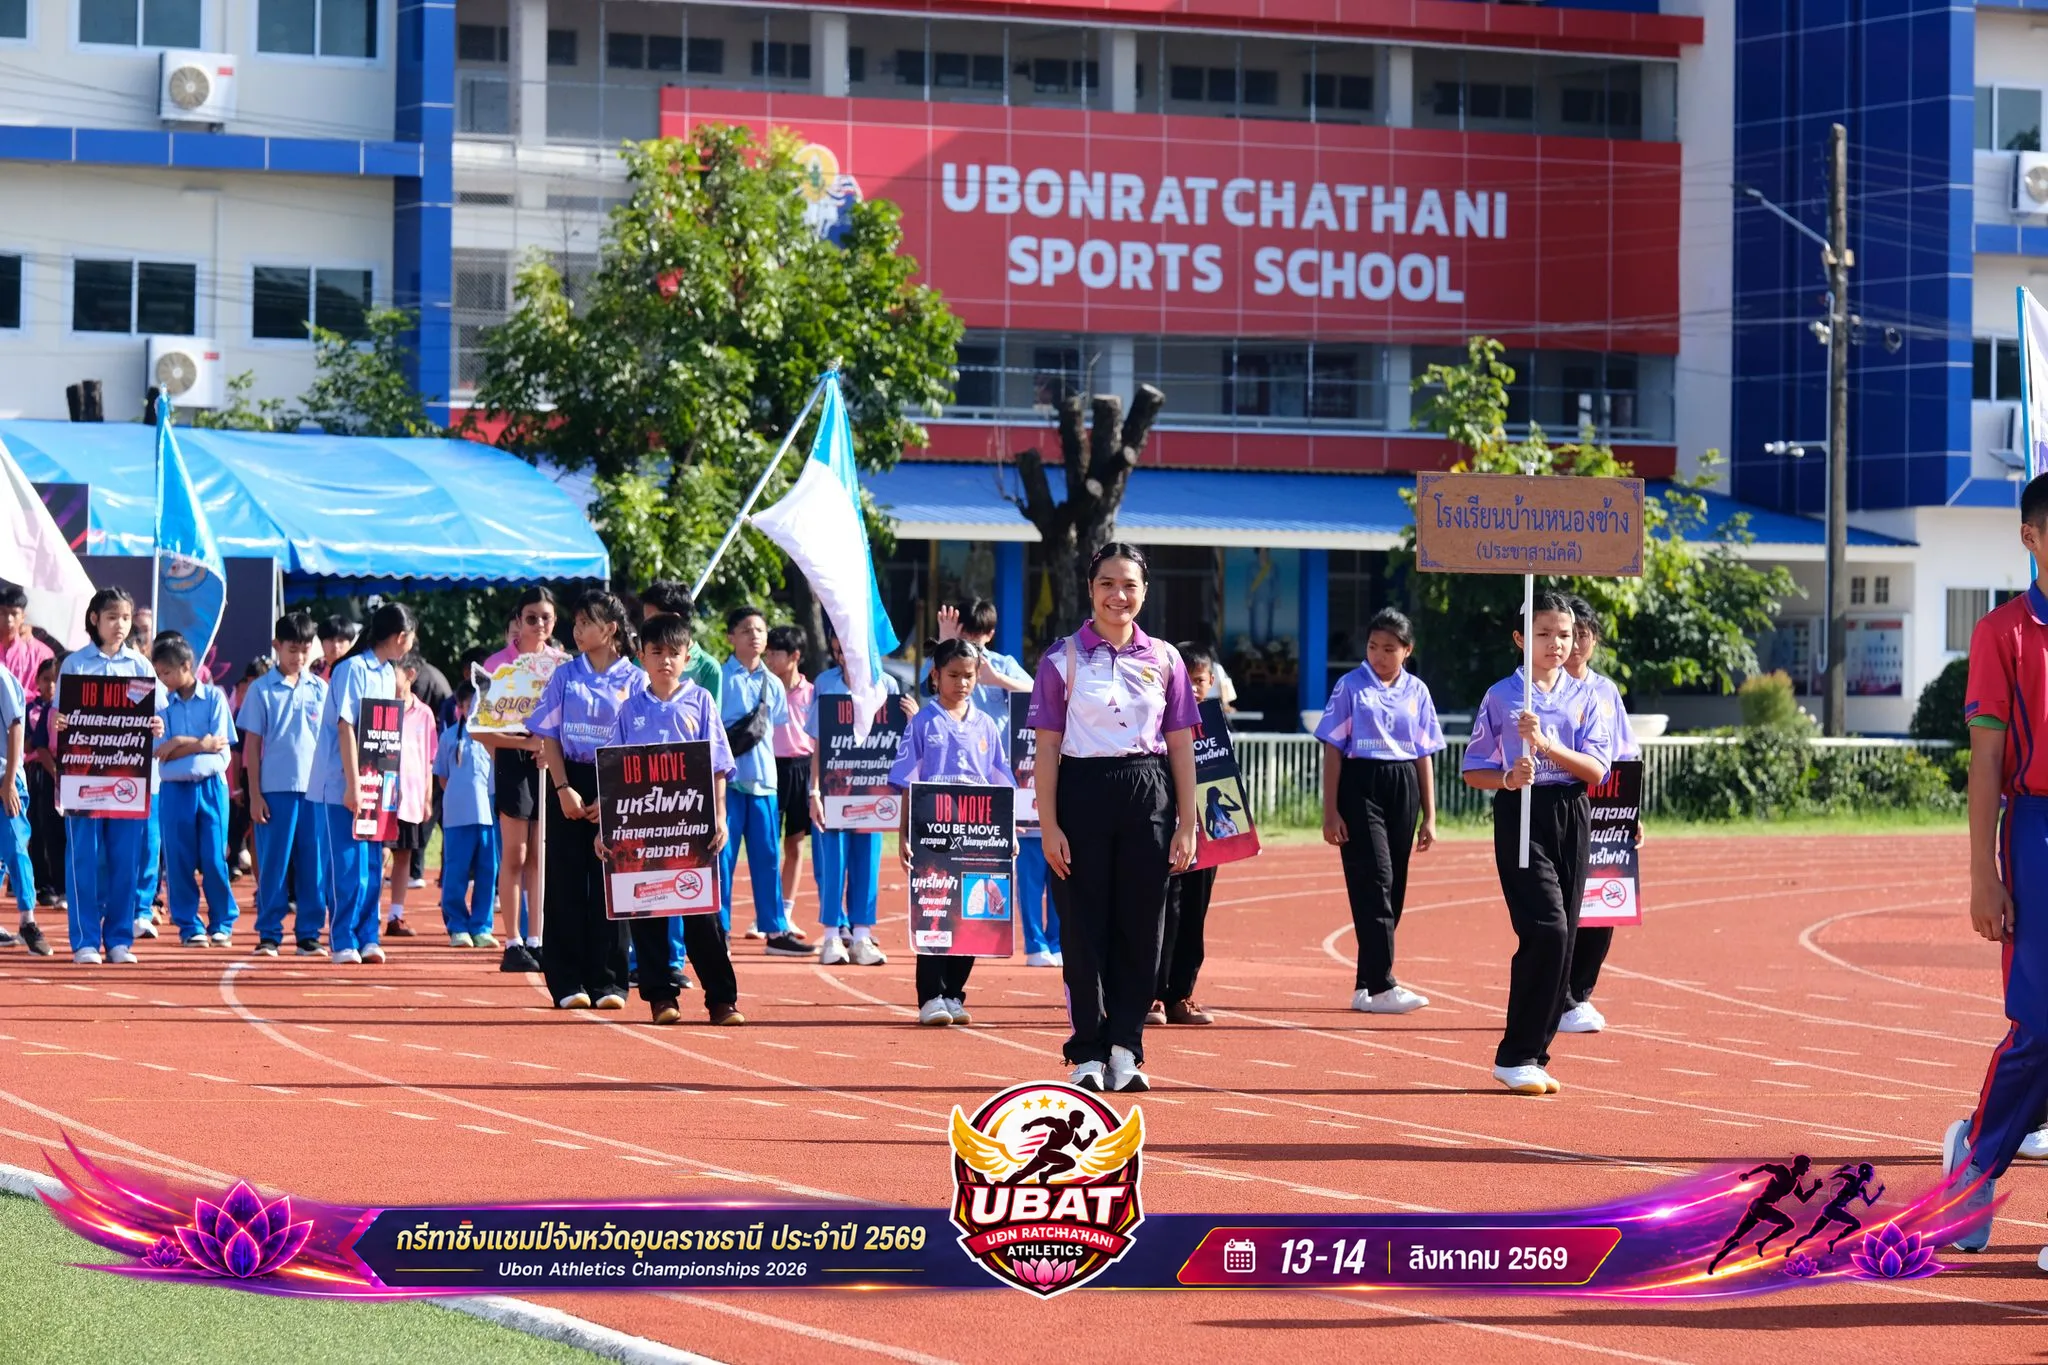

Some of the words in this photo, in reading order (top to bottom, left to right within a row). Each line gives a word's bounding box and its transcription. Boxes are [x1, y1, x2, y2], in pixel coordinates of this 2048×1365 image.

[942, 163, 1508, 239] UBONRATCHATHANI
[1008, 235, 1224, 293] SPORTS
[1253, 246, 1465, 304] SCHOOL
[1433, 492, 1630, 534] โรงเรียนบ้านหนองช้าง
[1476, 541, 1583, 563] (ประชาสามัคคี)
[82, 682, 98, 708] UB
[103, 683, 135, 709] MOV
[837, 700, 853, 725] UB
[68, 731, 146, 748] ประชาชนมีค่า
[1193, 737, 1218, 751] OVE
[623, 755, 643, 784] UB
[649, 752, 687, 783] MOVE
[616, 786, 704, 825] บุหรี่ไฟฟ้า
[935, 793, 952, 823] UB
[958, 795, 992, 825] MOVE
[612, 819, 709, 841] ทำลายความมั่นคง
[926, 823, 951, 834] YOU
[952, 824, 966, 835] BE
[968, 825, 1000, 836] MOVE
[636, 842, 690, 859] ของชาติ
[911, 872, 959, 894] บุหรี่ไฟฟ้า
